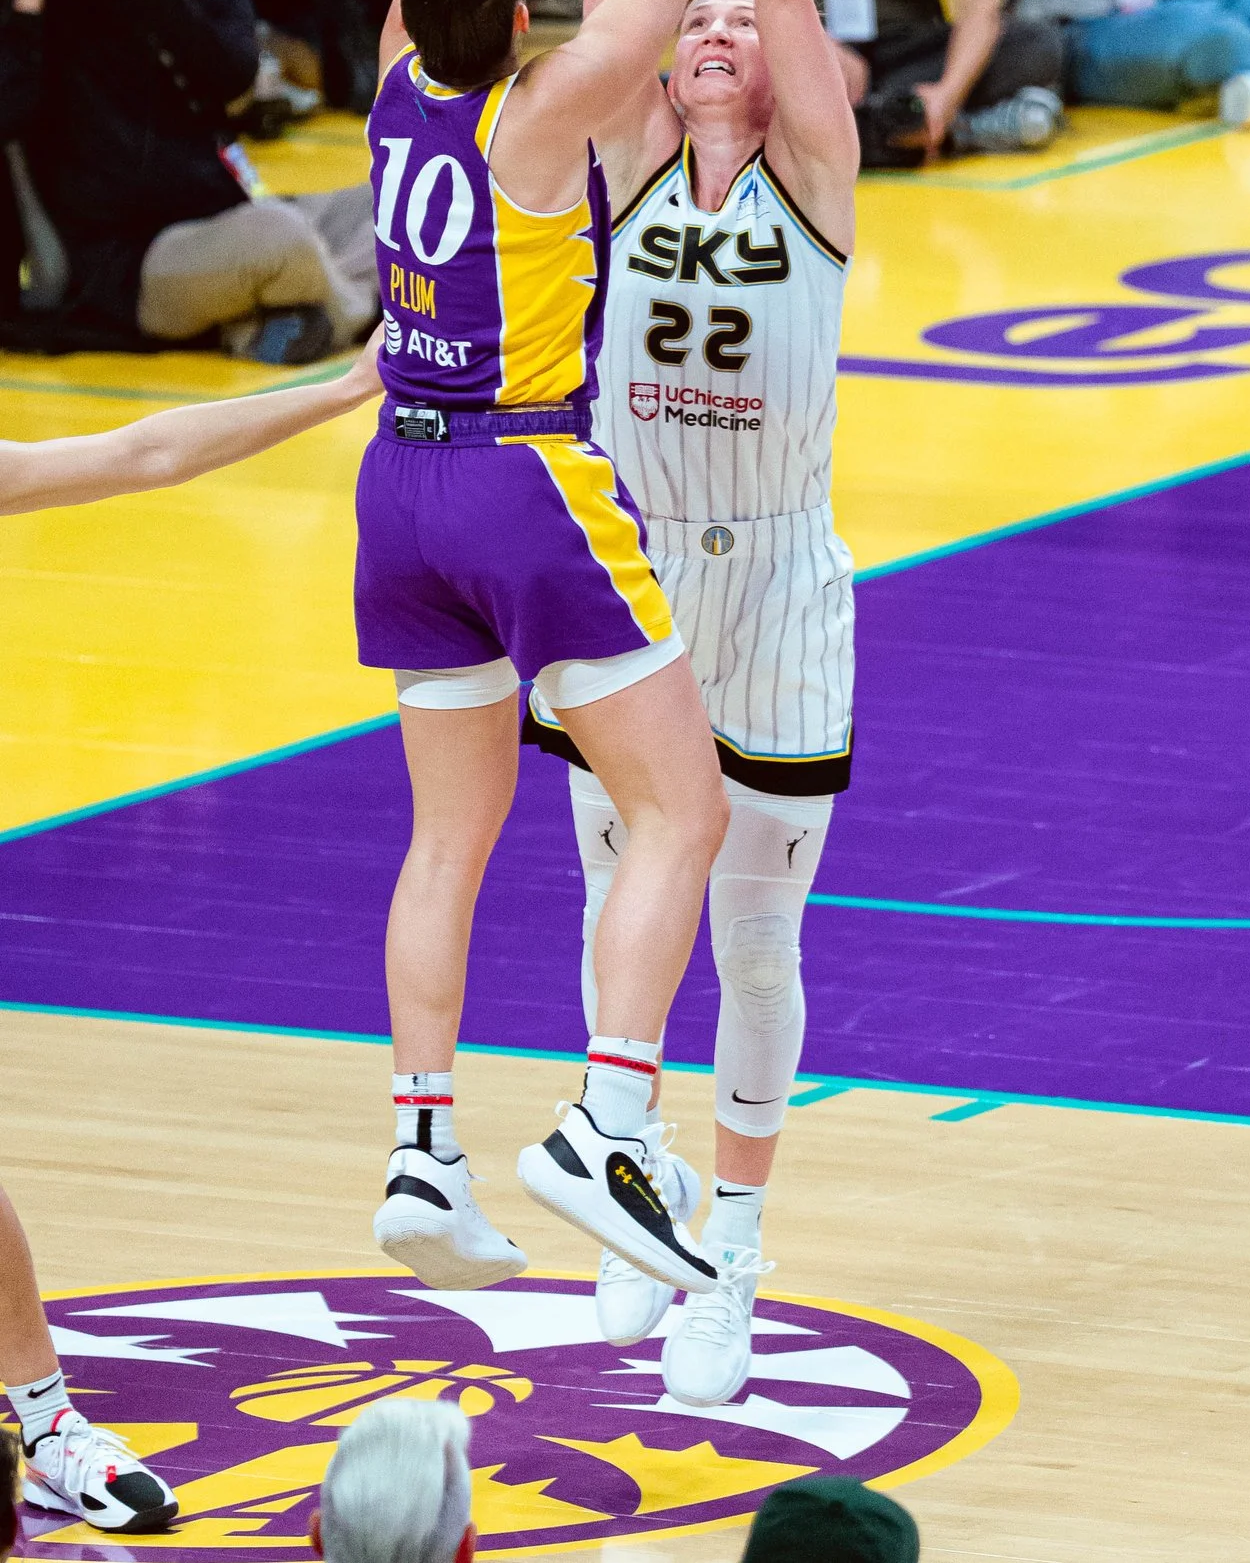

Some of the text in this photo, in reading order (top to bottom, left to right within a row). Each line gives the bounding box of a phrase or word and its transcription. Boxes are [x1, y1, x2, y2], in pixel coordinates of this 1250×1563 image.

[374, 137, 475, 266] 10
[627, 223, 792, 287] SKY
[390, 262, 437, 320] PLUM
[407, 328, 472, 368] AT&T
[644, 298, 752, 373] 22
[665, 384, 763, 414] UChicago
[665, 405, 761, 432] Medicine
